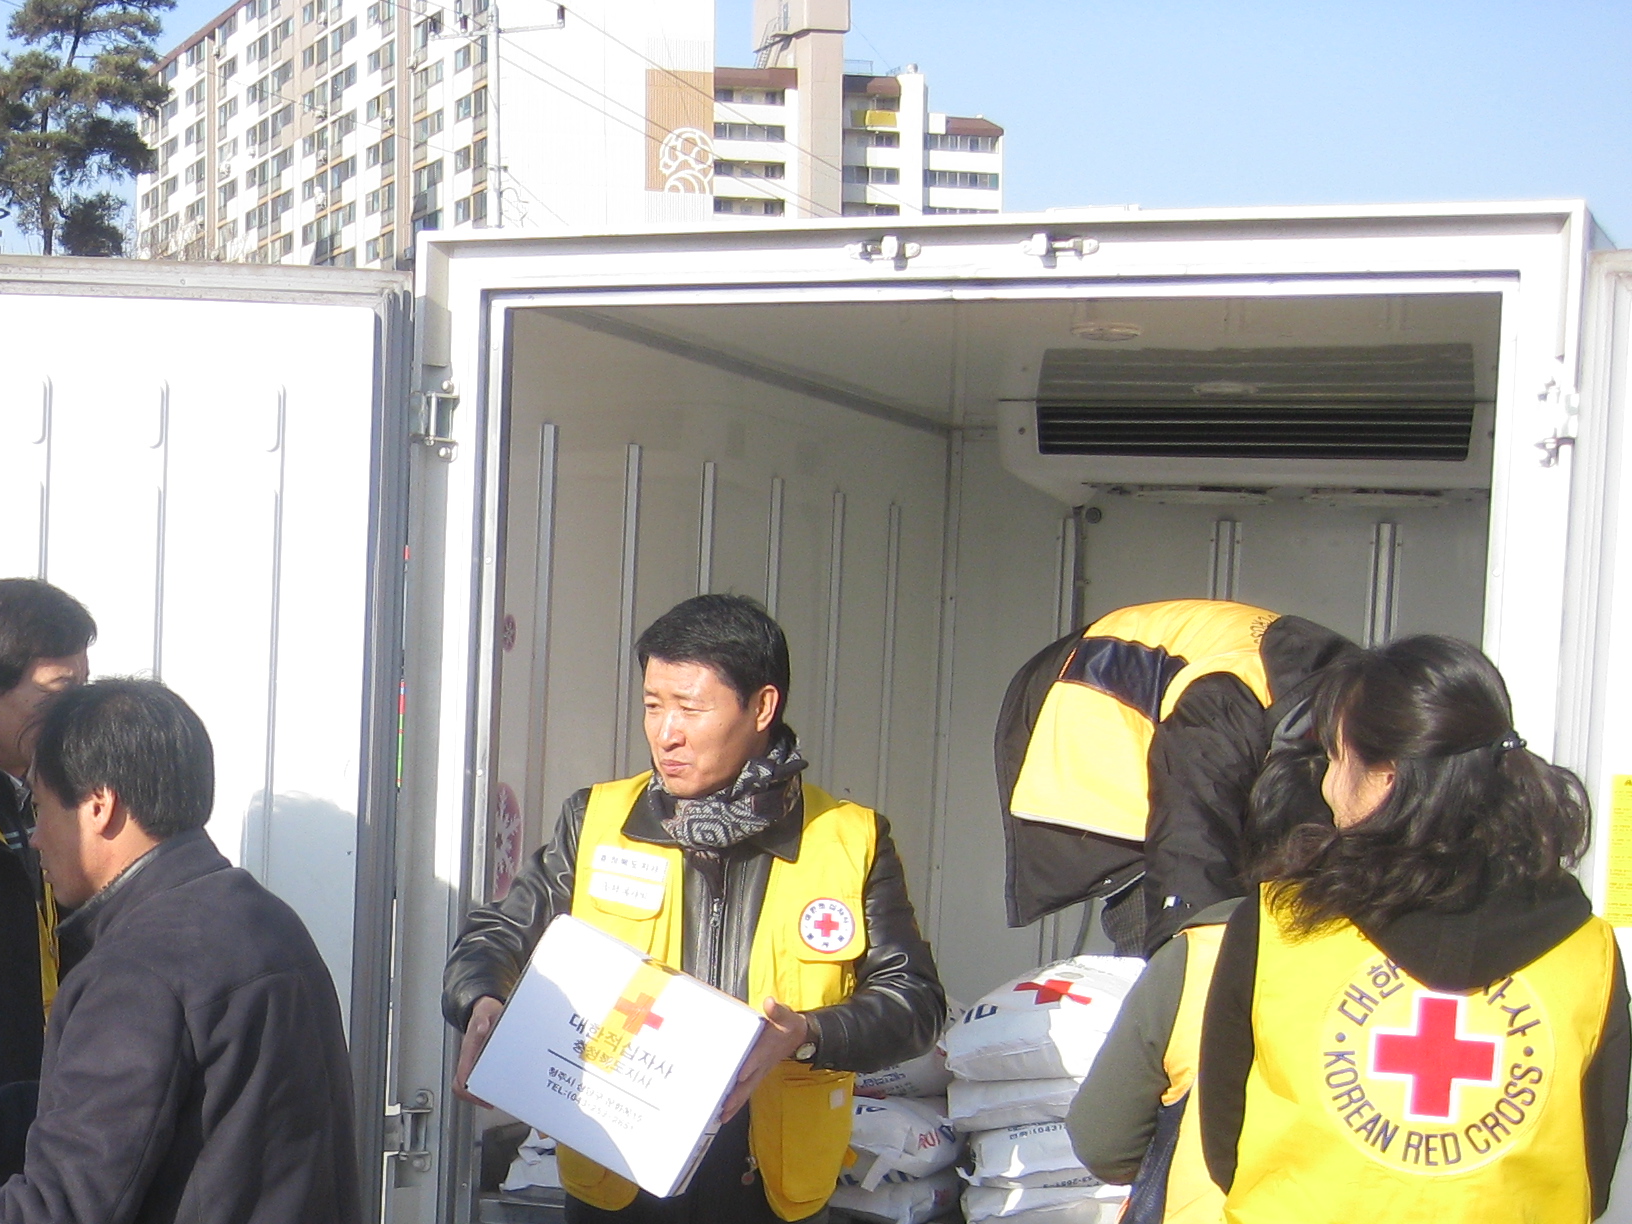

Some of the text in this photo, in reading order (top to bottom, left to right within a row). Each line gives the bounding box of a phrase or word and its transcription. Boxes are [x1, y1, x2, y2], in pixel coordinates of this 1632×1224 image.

[568, 1012, 674, 1079] 대한적십자사
[1323, 1049, 1544, 1167] KOREAN RED CROSS
